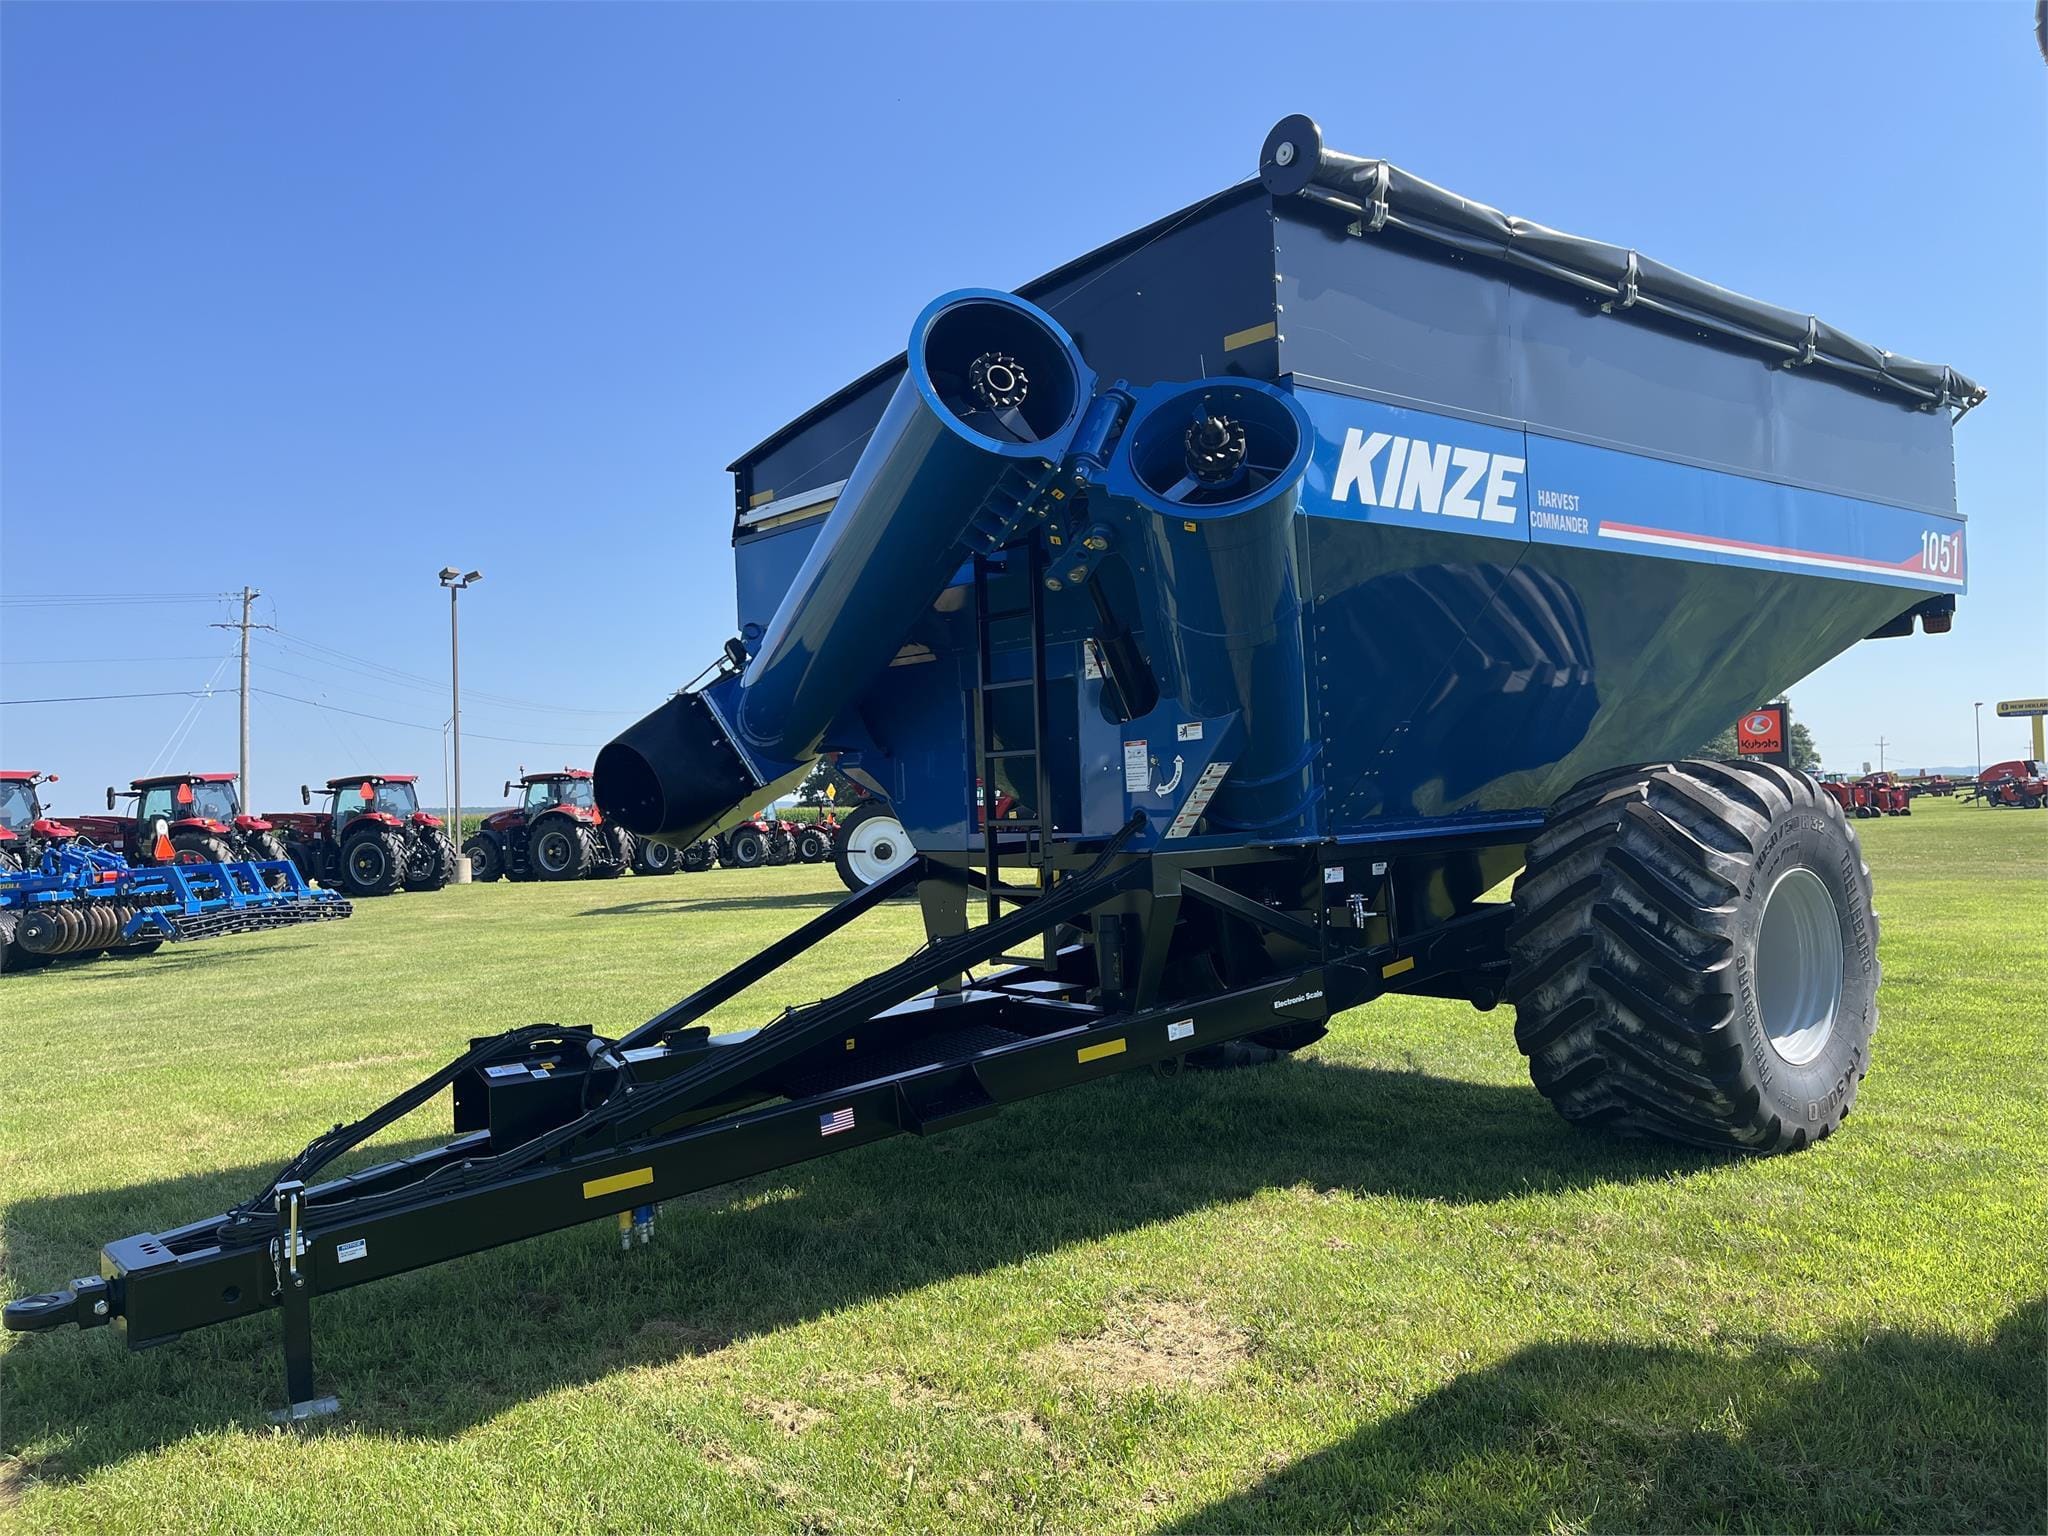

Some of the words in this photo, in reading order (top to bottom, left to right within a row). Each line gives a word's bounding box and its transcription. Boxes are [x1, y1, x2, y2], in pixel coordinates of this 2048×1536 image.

[1331, 427, 1526, 524] KINZE
[1537, 489, 1580, 512] HARVEST
[1530, 510, 1589, 535] COMMANDER
[1921, 530, 1959, 575] 1051
[1741, 739, 1779, 749] Kubota
[1273, 994, 1306, 1009] Electronic
[1305, 989, 1323, 1000] Scale
